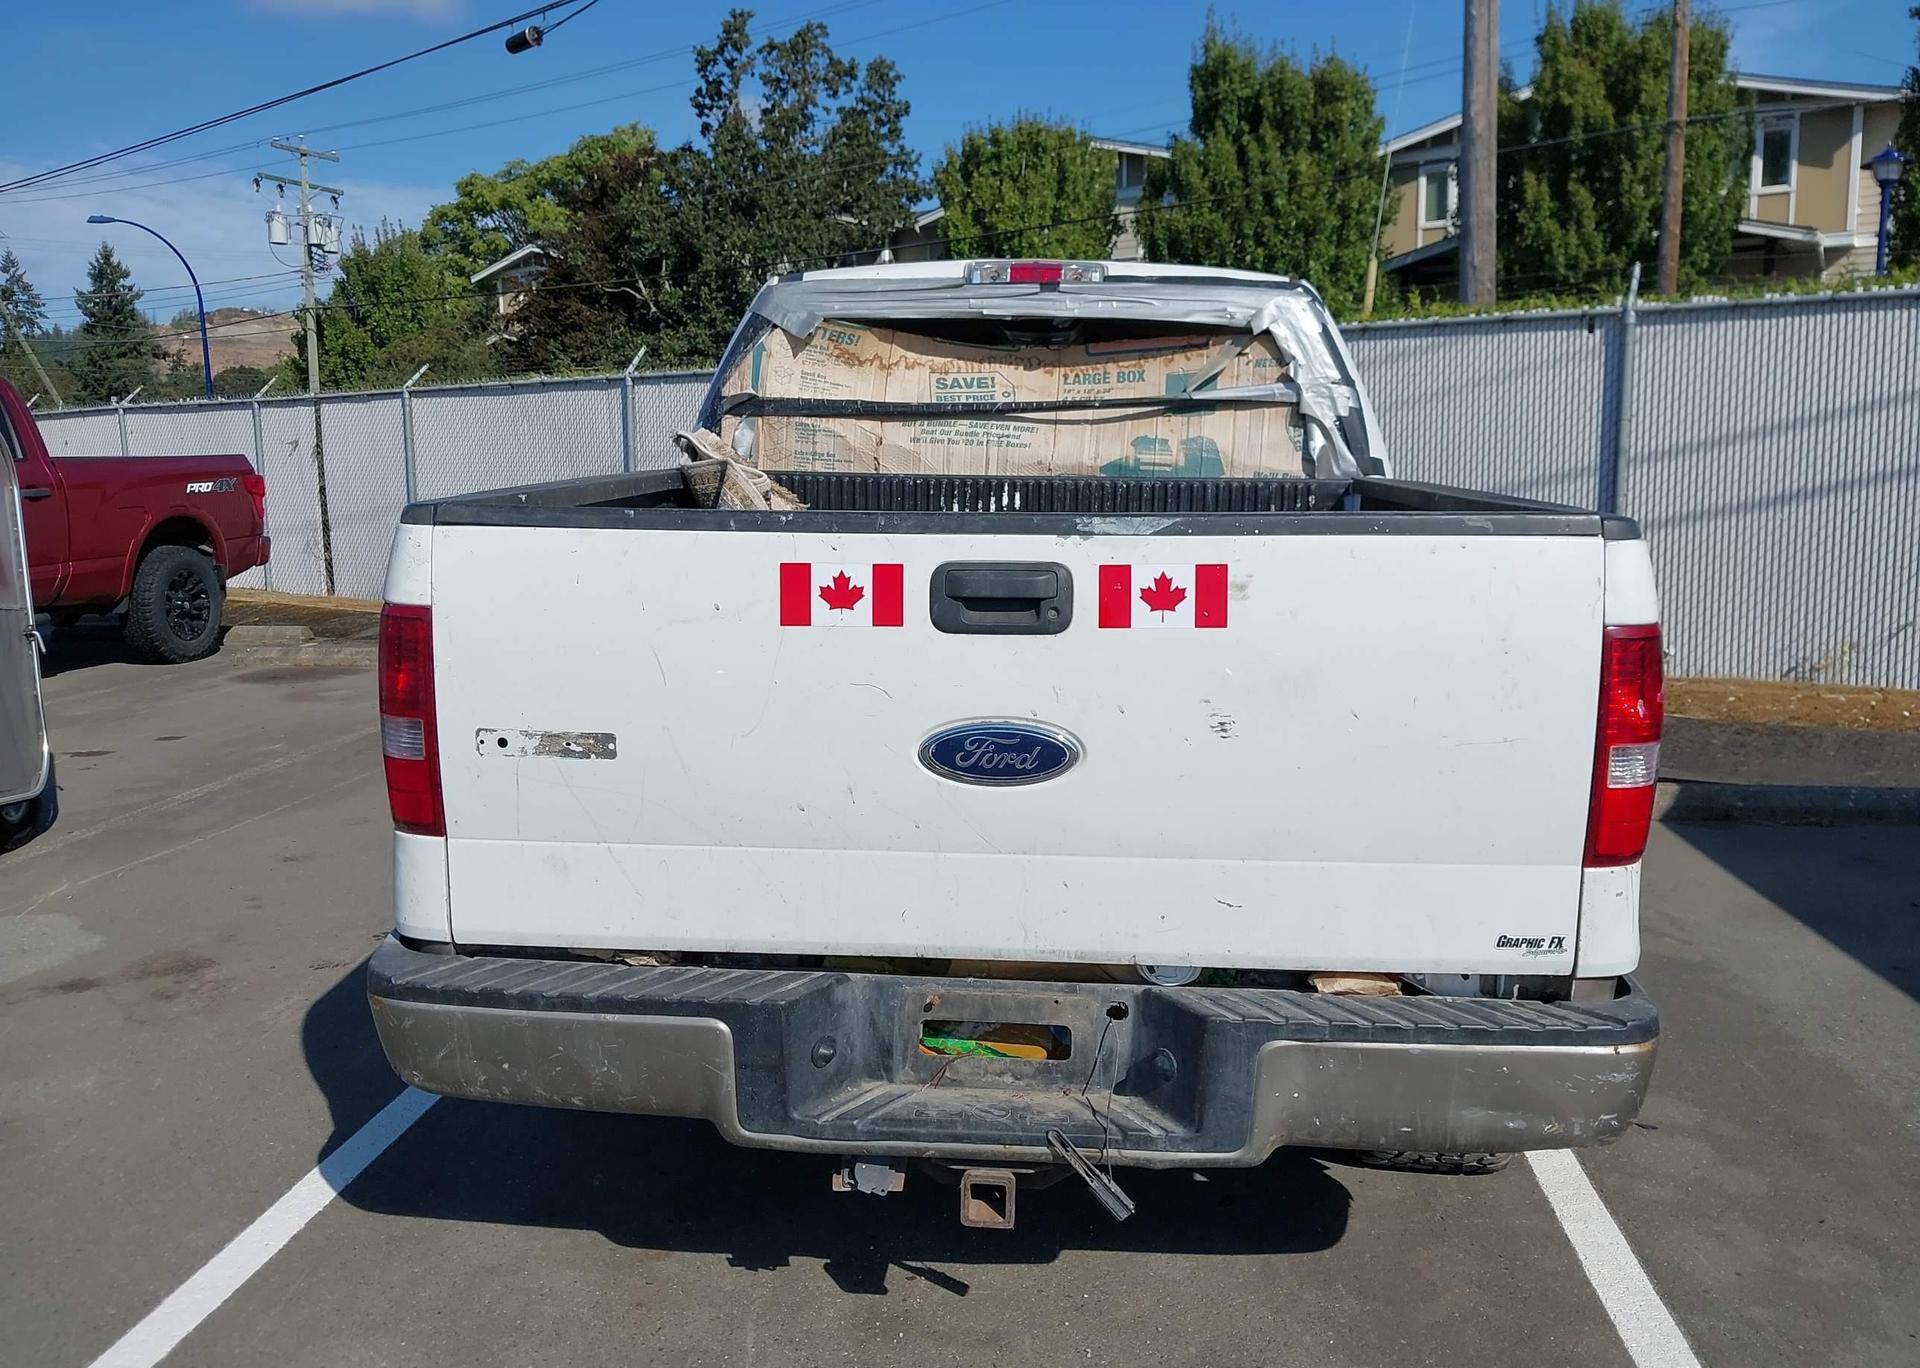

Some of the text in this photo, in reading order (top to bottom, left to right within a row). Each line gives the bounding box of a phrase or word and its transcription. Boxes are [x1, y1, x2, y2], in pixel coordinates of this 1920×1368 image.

[935, 376, 996, 390] SAVE!
[1063, 369, 1146, 385] LARGE BOX
[935, 394, 996, 403] BEST PRICE
[954, 430, 980, 438] Bundle
[990, 423, 1011, 431] EVEN
[1012, 425, 1039, 434] MORE!
[946, 438, 960, 446] You
[1006, 441, 1032, 449] Boxes!
[955, 735, 1041, 769] Ford
[1547, 936, 1566, 949] FX
